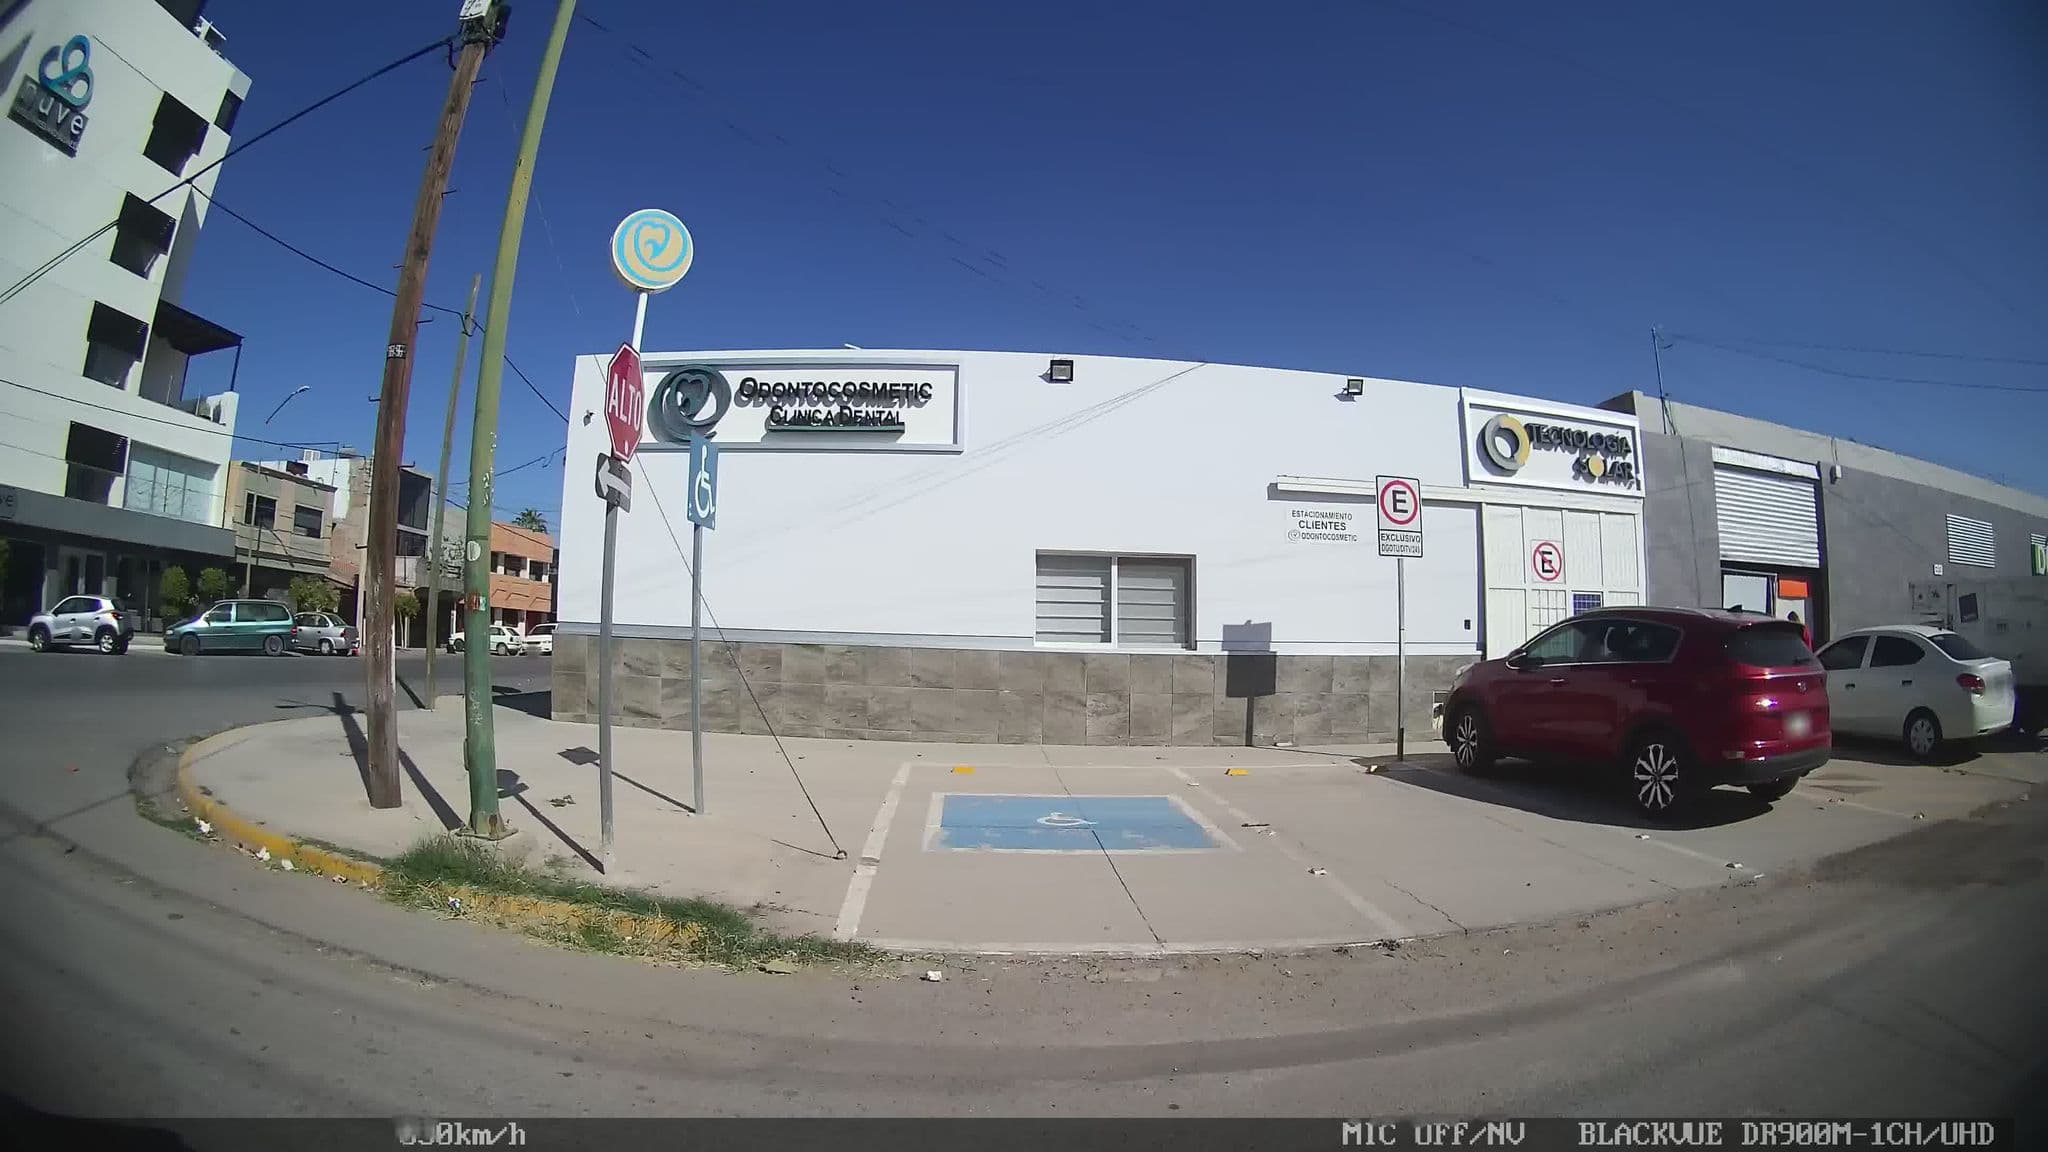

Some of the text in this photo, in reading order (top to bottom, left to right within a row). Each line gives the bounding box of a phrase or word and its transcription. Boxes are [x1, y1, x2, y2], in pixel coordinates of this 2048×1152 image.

[739, 377, 933, 401] ODONTOCOSMETIC
[608, 372, 641, 431] ALTO
[839, 405, 905, 426] DENTAL
[1391, 489, 1409, 514] E
[1291, 510, 1353, 521] ESTACIONAMIENTO
[1298, 520, 1347, 531] CLIENTES
[1301, 532, 1358, 542] ODONTOCOSMETIC
[1380, 533, 1421, 543] EXCLUSIVO
[1540, 550, 1554, 574] E
